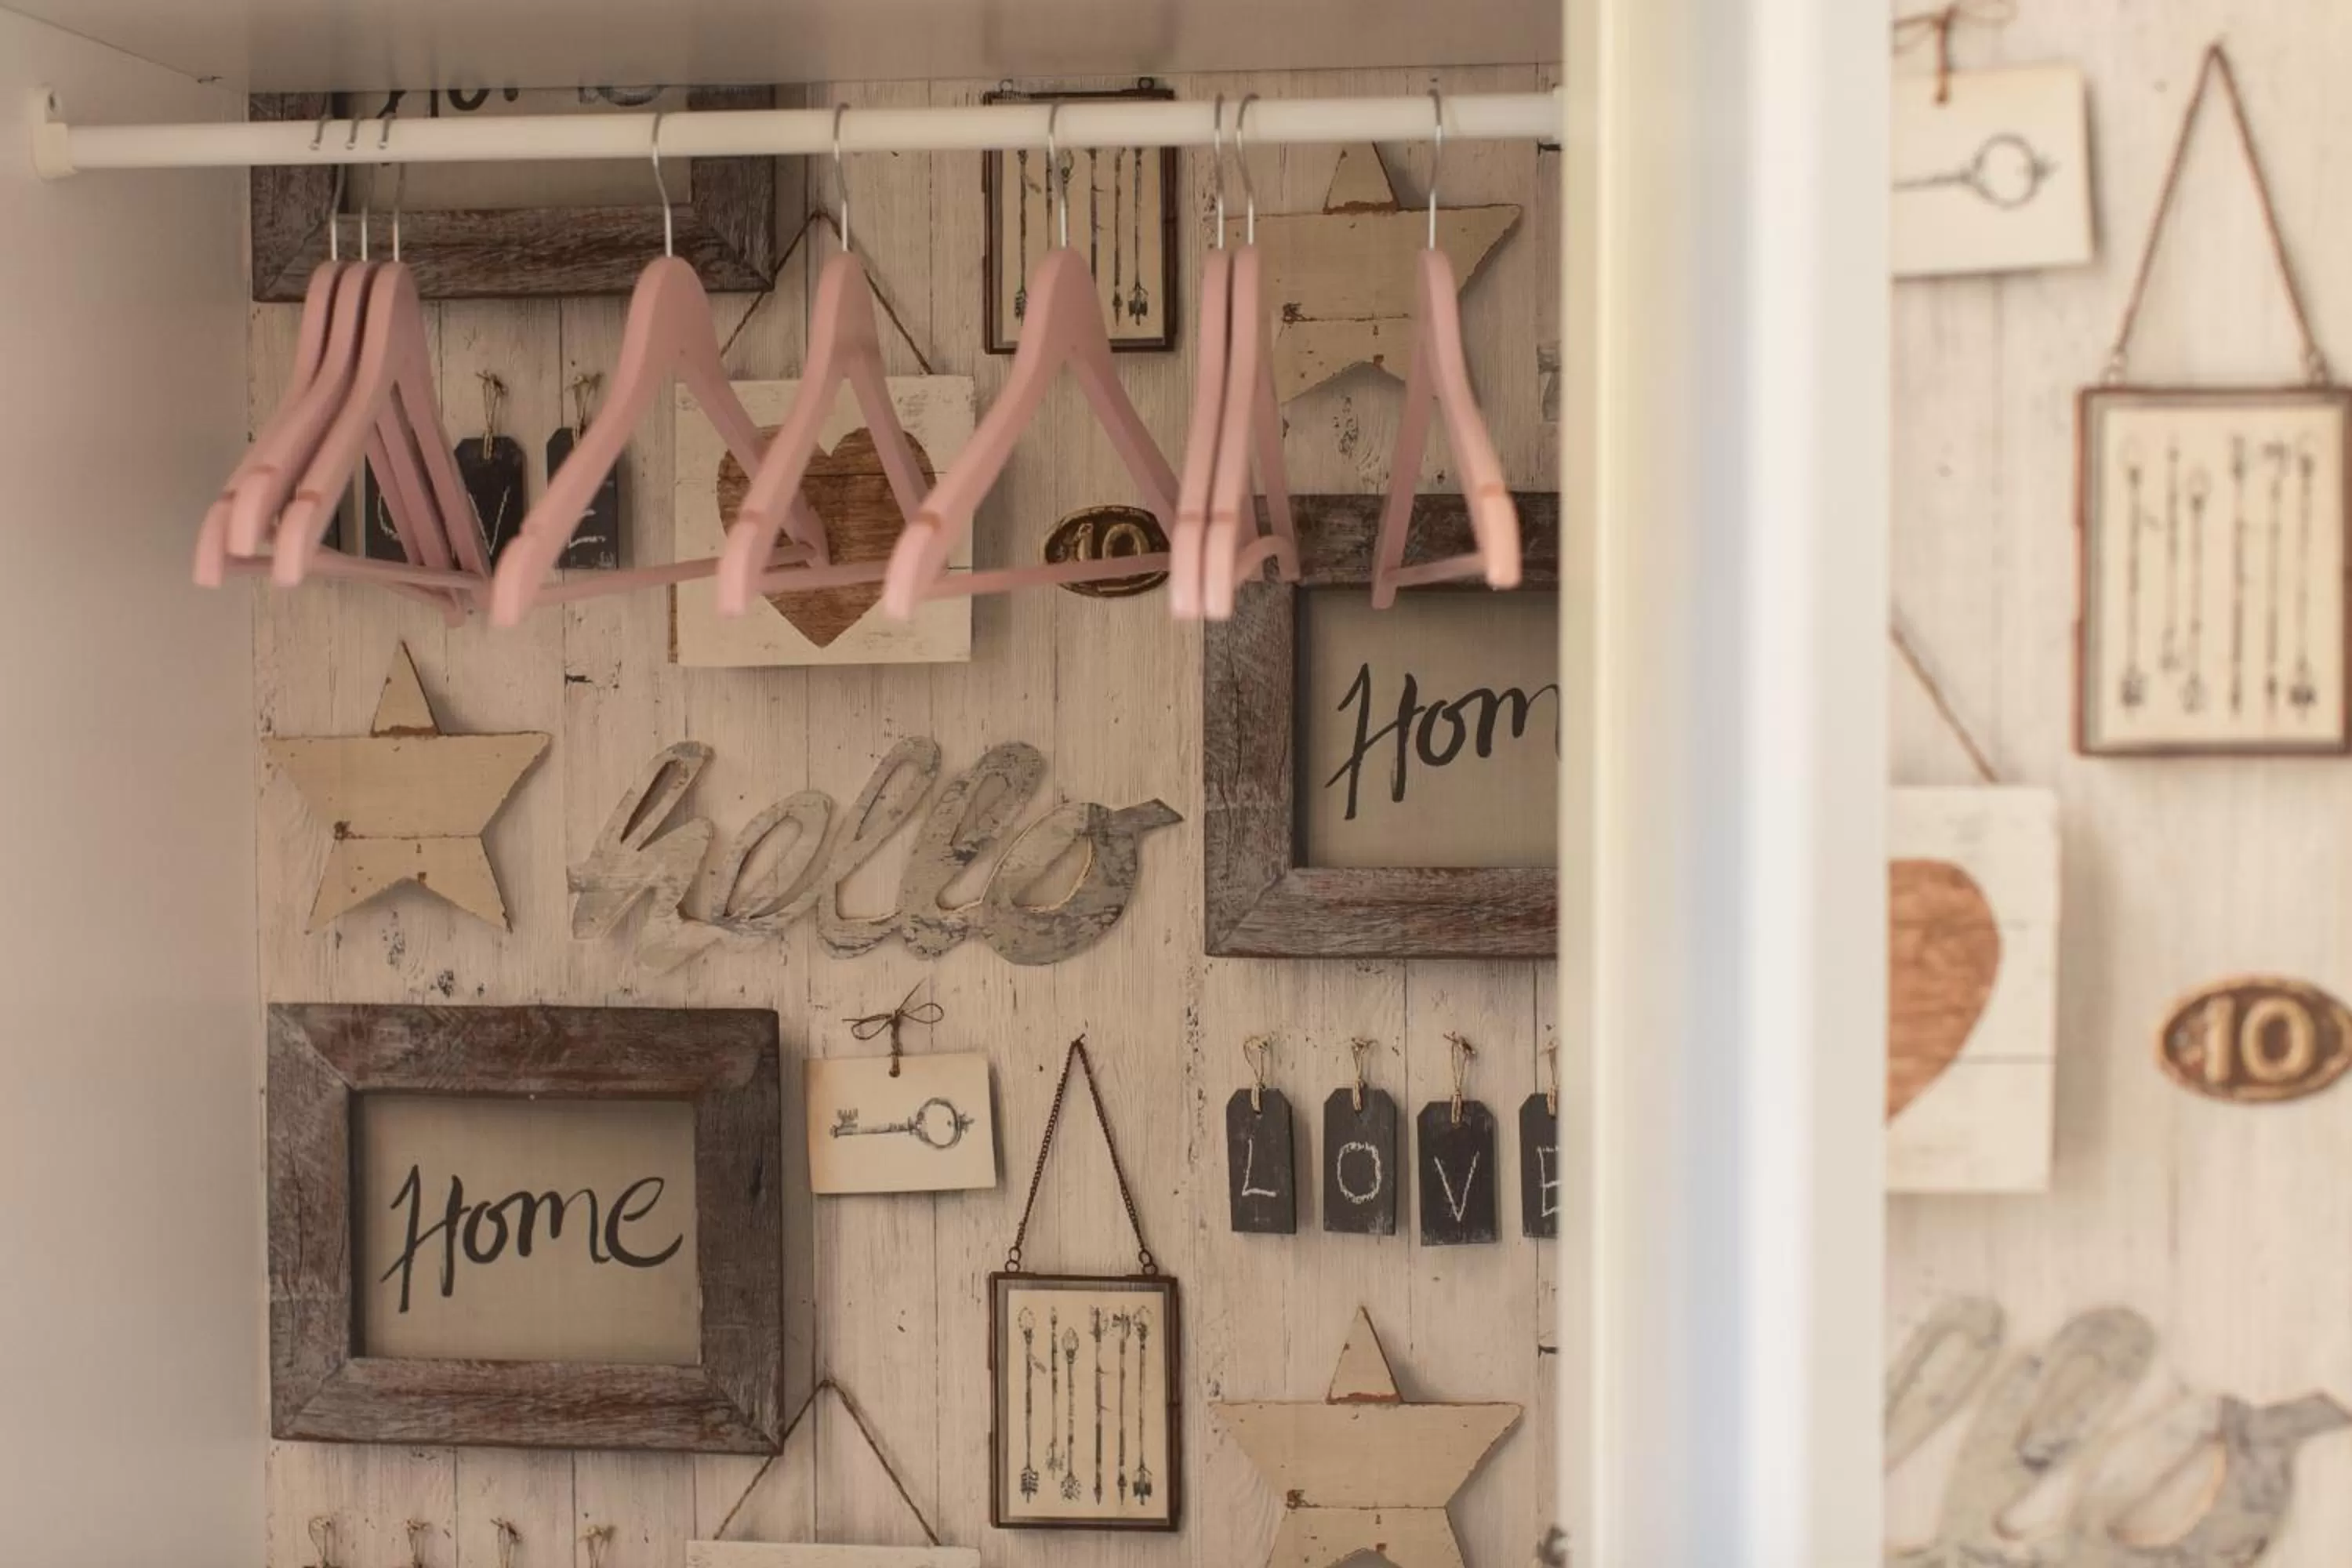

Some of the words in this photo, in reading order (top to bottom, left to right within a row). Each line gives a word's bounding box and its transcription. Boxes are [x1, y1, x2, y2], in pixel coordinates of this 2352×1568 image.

[1324, 662, 1560, 821] Hom
[566, 734, 1185, 975] hello
[2203, 994, 2318, 1085] 10
[380, 1164, 684, 1313] Home
